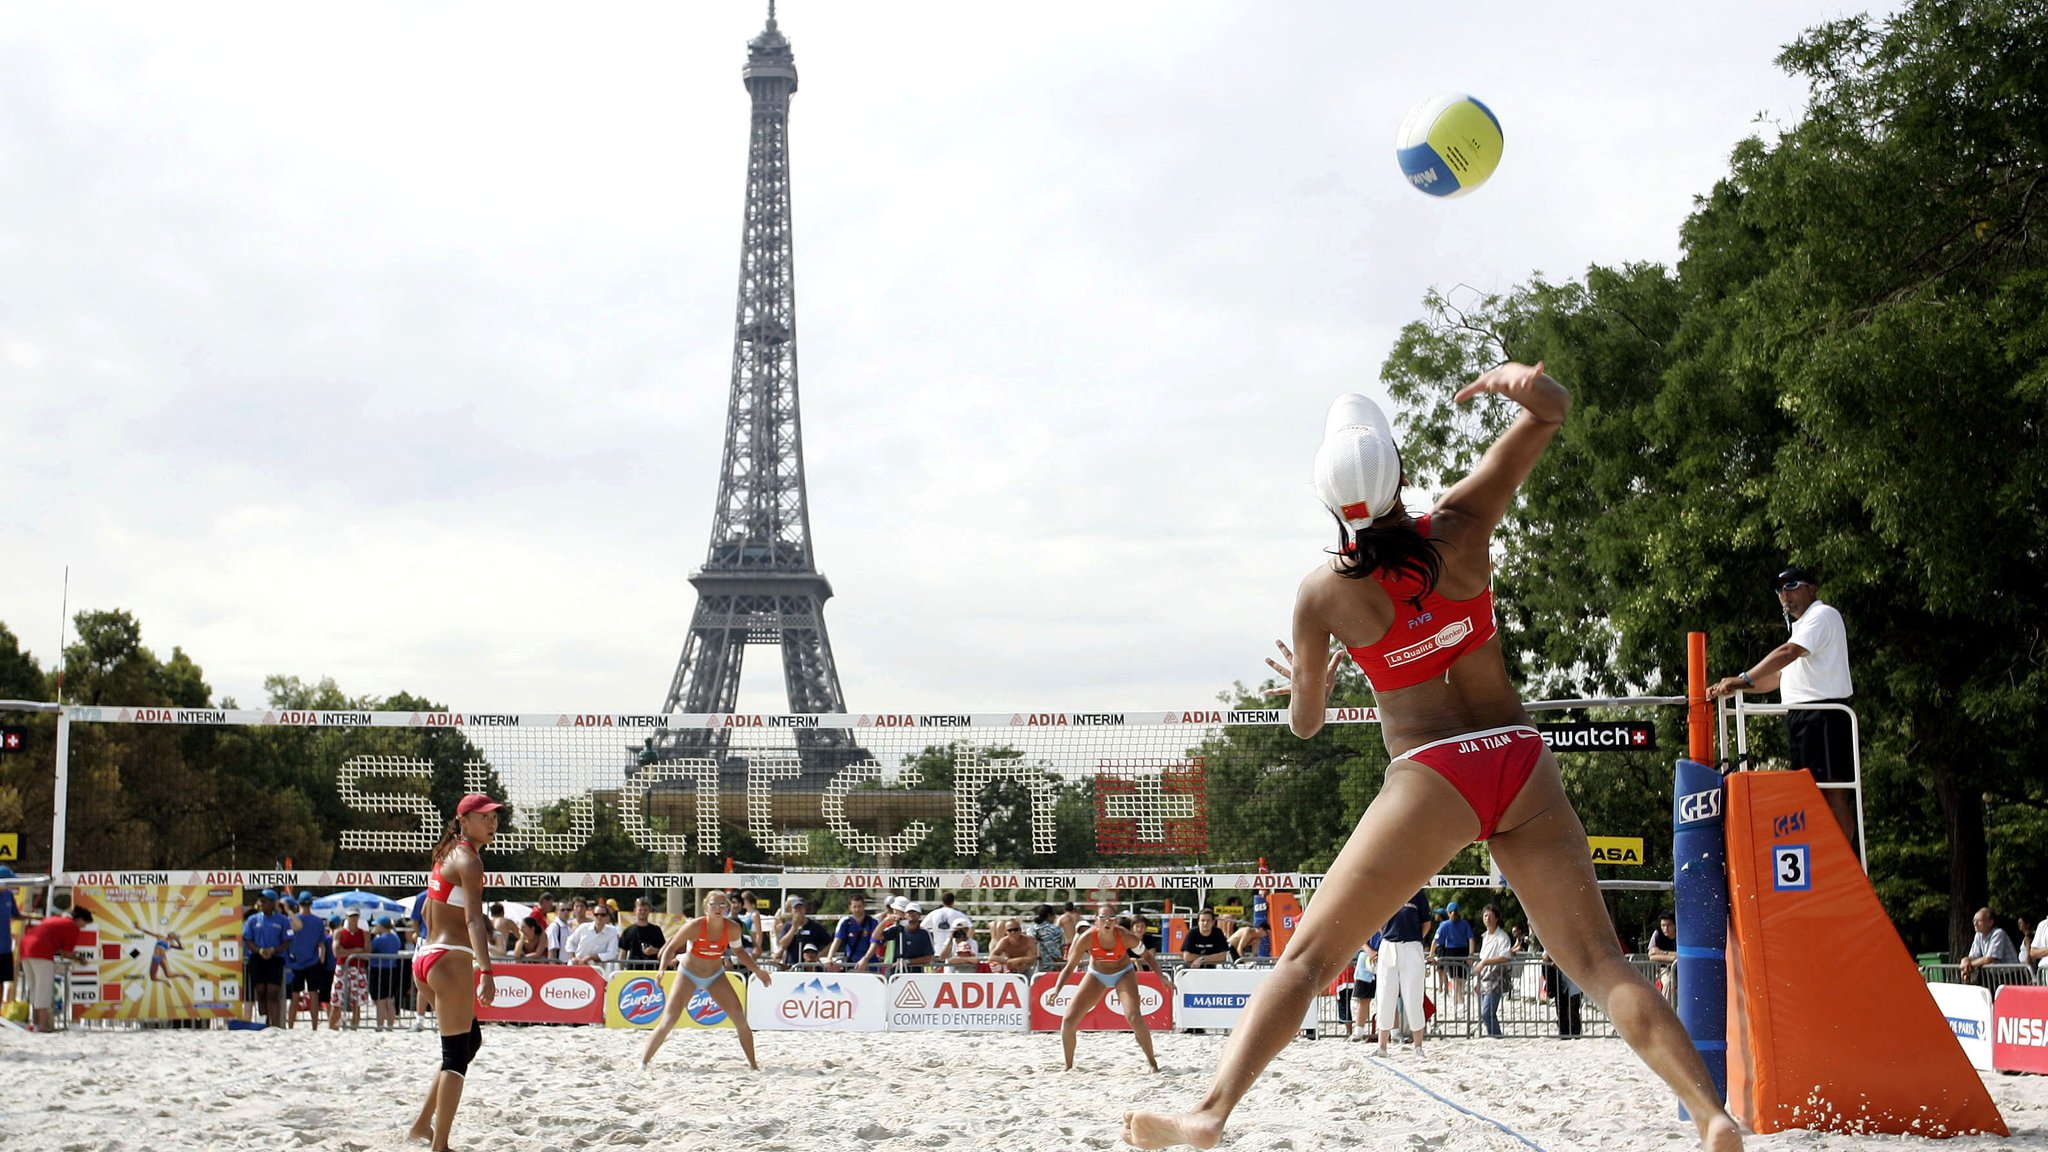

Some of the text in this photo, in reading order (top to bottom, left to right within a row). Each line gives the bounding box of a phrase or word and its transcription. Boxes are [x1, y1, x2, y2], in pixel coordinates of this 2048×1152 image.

[1391, 626, 1463, 663] La Qualité Henkel
[134, 710, 226, 723] ADIA INTERIM
[280, 712, 372, 725] ADIA INTERIM
[426, 714, 519, 726] ADIA INTERIM
[1027, 714, 1125, 726] ADIA INTERIM
[1182, 711, 1279, 723] ADIA INTERIM
[1336, 708, 1377, 720] ADIA
[574, 715, 668, 727] ADIA INTERIM
[724, 715, 819, 727] ADIA INTERIM
[875, 715, 971, 727] ADIA INTERIM
[1541, 726, 1629, 747] swatch
[1458, 734, 1513, 754] JIA TIAN
[1680, 789, 1720, 823] GES
[1774, 810, 1807, 838] GES
[1780, 853, 1801, 883] 3
[77, 874, 168, 886] ADIA INTERIM
[206, 873, 298, 884] ADIA INTERIM
[336, 872, 374, 885] ADIA
[379, 873, 428, 886] INTERIM
[510, 875, 561, 887] INTERIM
[598, 875, 694, 887] ADIA INTERIM
[843, 875, 940, 888] ADIA INTERIM
[979, 875, 1076, 888] ADIA INTERIM
[1115, 875, 1213, 888] ADIA INTERIM
[1253, 875, 1294, 887] ADIA
[1285, 918, 1291, 927] 5
[223, 947, 234, 957] 11
[73, 991, 96, 1000] NED
[200, 987, 206, 997] 1
[222, 987, 235, 997] 14
[494, 986, 528, 998] enkel
[545, 987, 591, 1000] Henkel
[933, 982, 1022, 1009] ADIA
[620, 993, 663, 1010] Europe
[782, 996, 852, 1019] evian
[1193, 997, 1233, 1006] MAIRIE
[893, 1013, 1022, 1025] COMITE D'ENTREPRISE
[1958, 1021, 1975, 1036] PARIS
